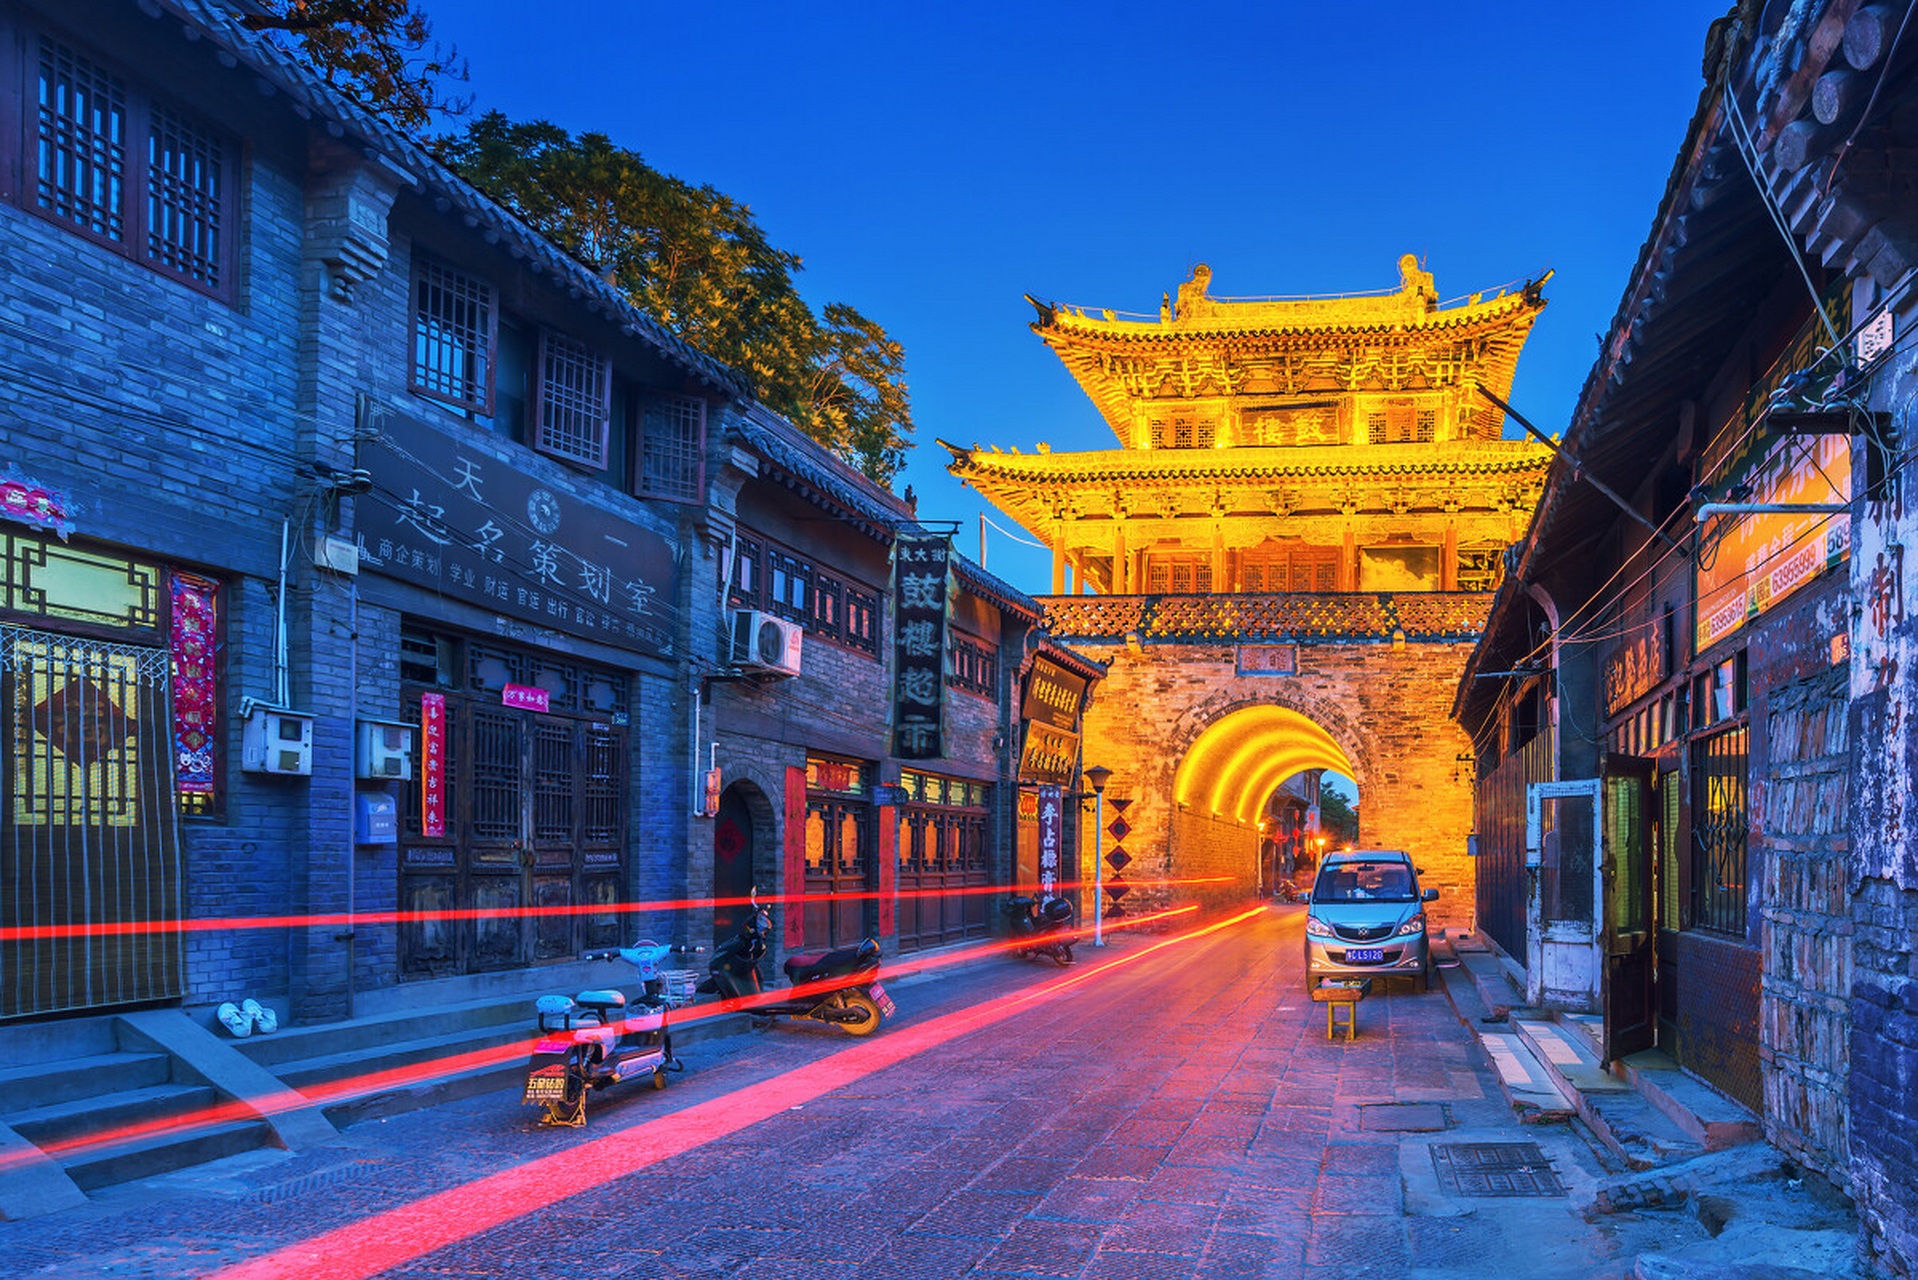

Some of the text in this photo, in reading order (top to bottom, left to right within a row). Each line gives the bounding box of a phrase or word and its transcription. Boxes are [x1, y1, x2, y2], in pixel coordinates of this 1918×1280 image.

[453, 456, 484, 502] 天
[378, 538, 440, 577] 商企策划
[449, 563, 476, 589] 学业
[547, 598, 568, 619] 出行
[395, 487, 656, 617] 起名策划室
